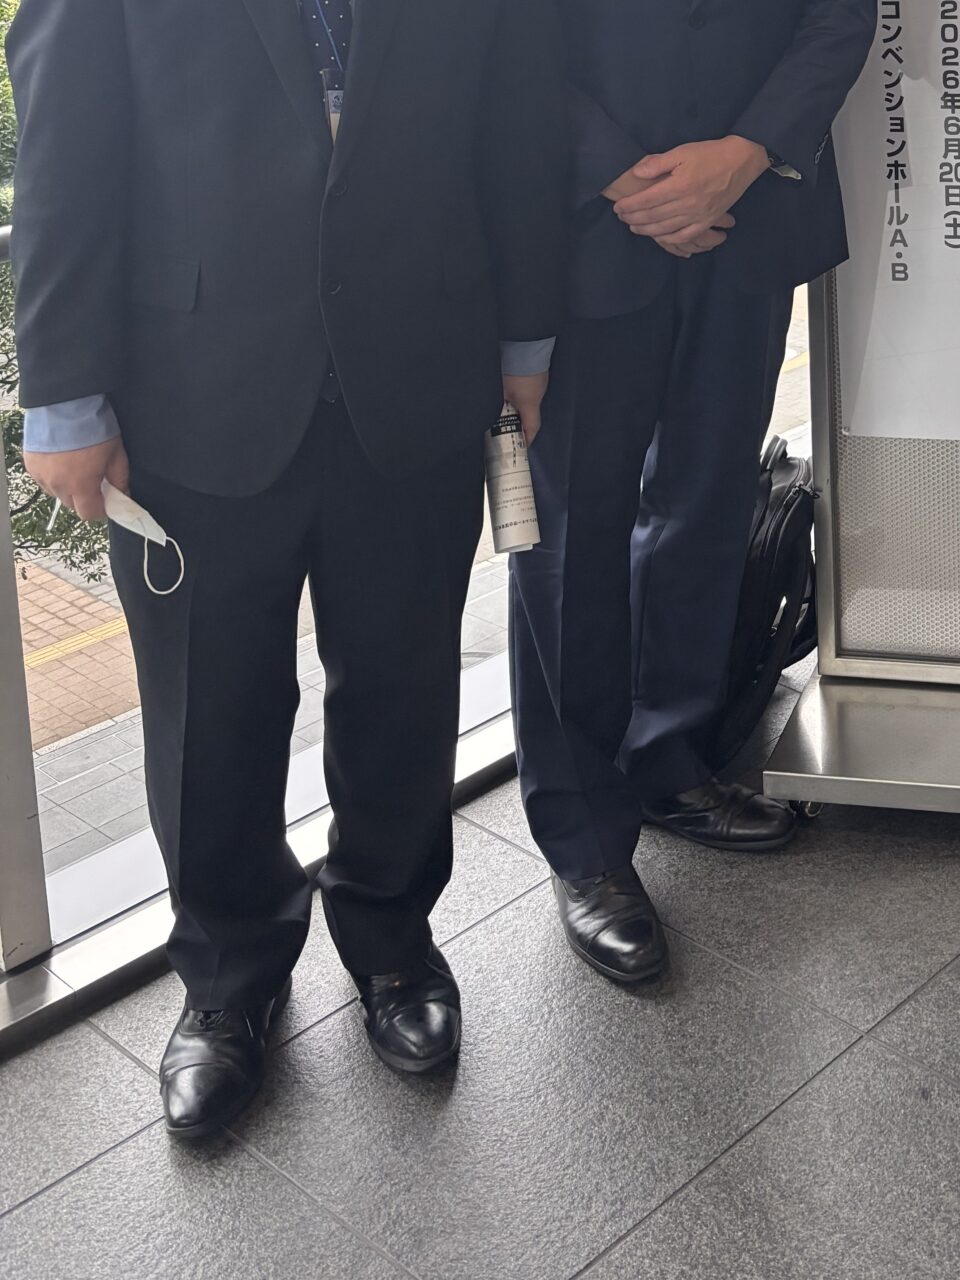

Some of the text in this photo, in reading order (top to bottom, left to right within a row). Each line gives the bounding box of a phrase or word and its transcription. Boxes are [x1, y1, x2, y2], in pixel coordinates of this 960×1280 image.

[881, 1, 909, 282] コンベンションホールA・B
